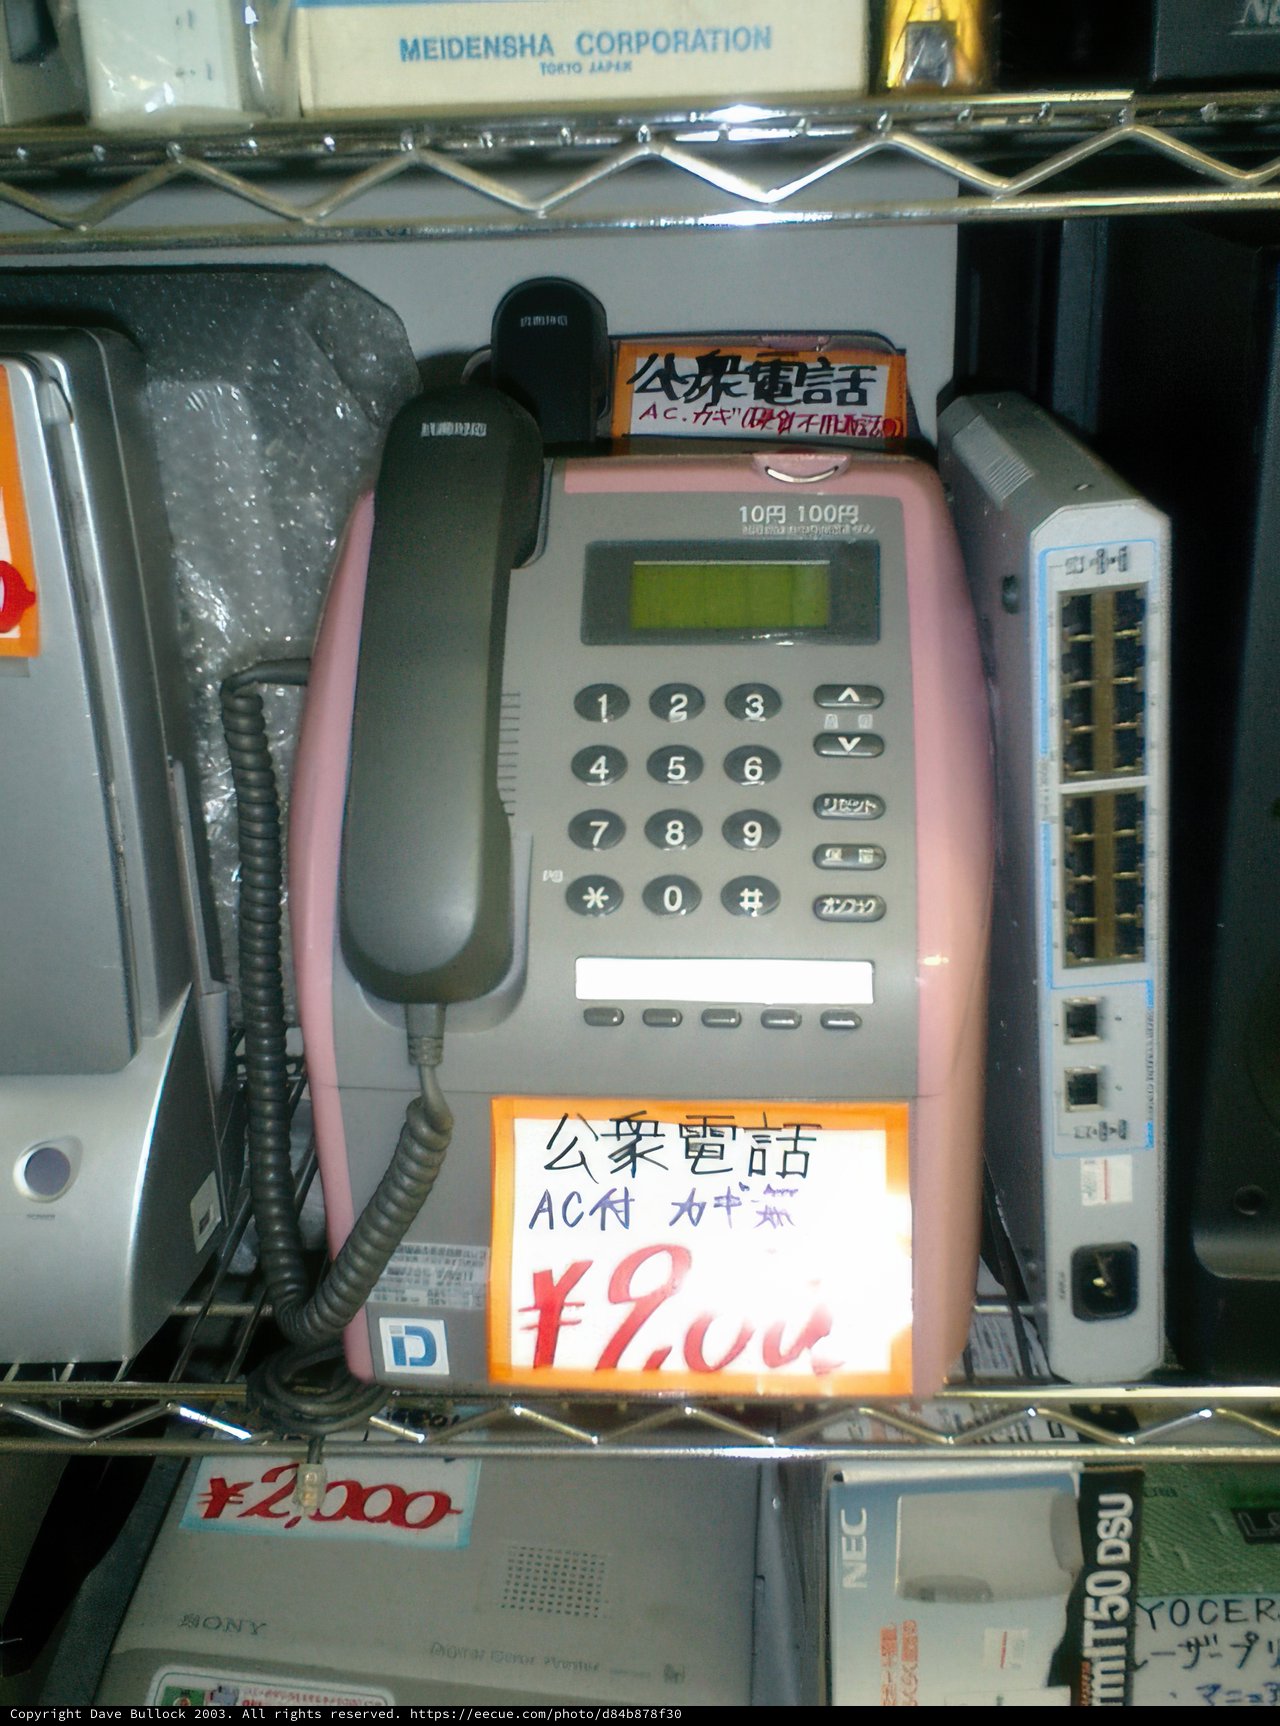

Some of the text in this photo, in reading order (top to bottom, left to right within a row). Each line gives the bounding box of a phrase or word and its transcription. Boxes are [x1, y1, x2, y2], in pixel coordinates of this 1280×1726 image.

[400, 25, 773, 62] MEIDENSHA CORPORATION
[540, 61, 583, 75] TOKYO
[627, 350, 877, 406] 公衆電話
[740, 504, 859, 524] 10円 100円
[597, 693, 764, 718] 1 2 3
[589, 755, 763, 781] 4 5 6
[589, 820, 763, 847] 7 8 9
[663, 885, 683, 912] 0
[739, 887, 763, 910] #
[543, 1111, 823, 1184] 公衆電話
[528, 1186, 636, 1231] AC付
[197, 1462, 463, 1530] ¥2,000
[1096, 1492, 1134, 1565] DSU
[841, 1507, 867, 1589] NEC
[1136, 1598, 1280, 1630] YOCER
